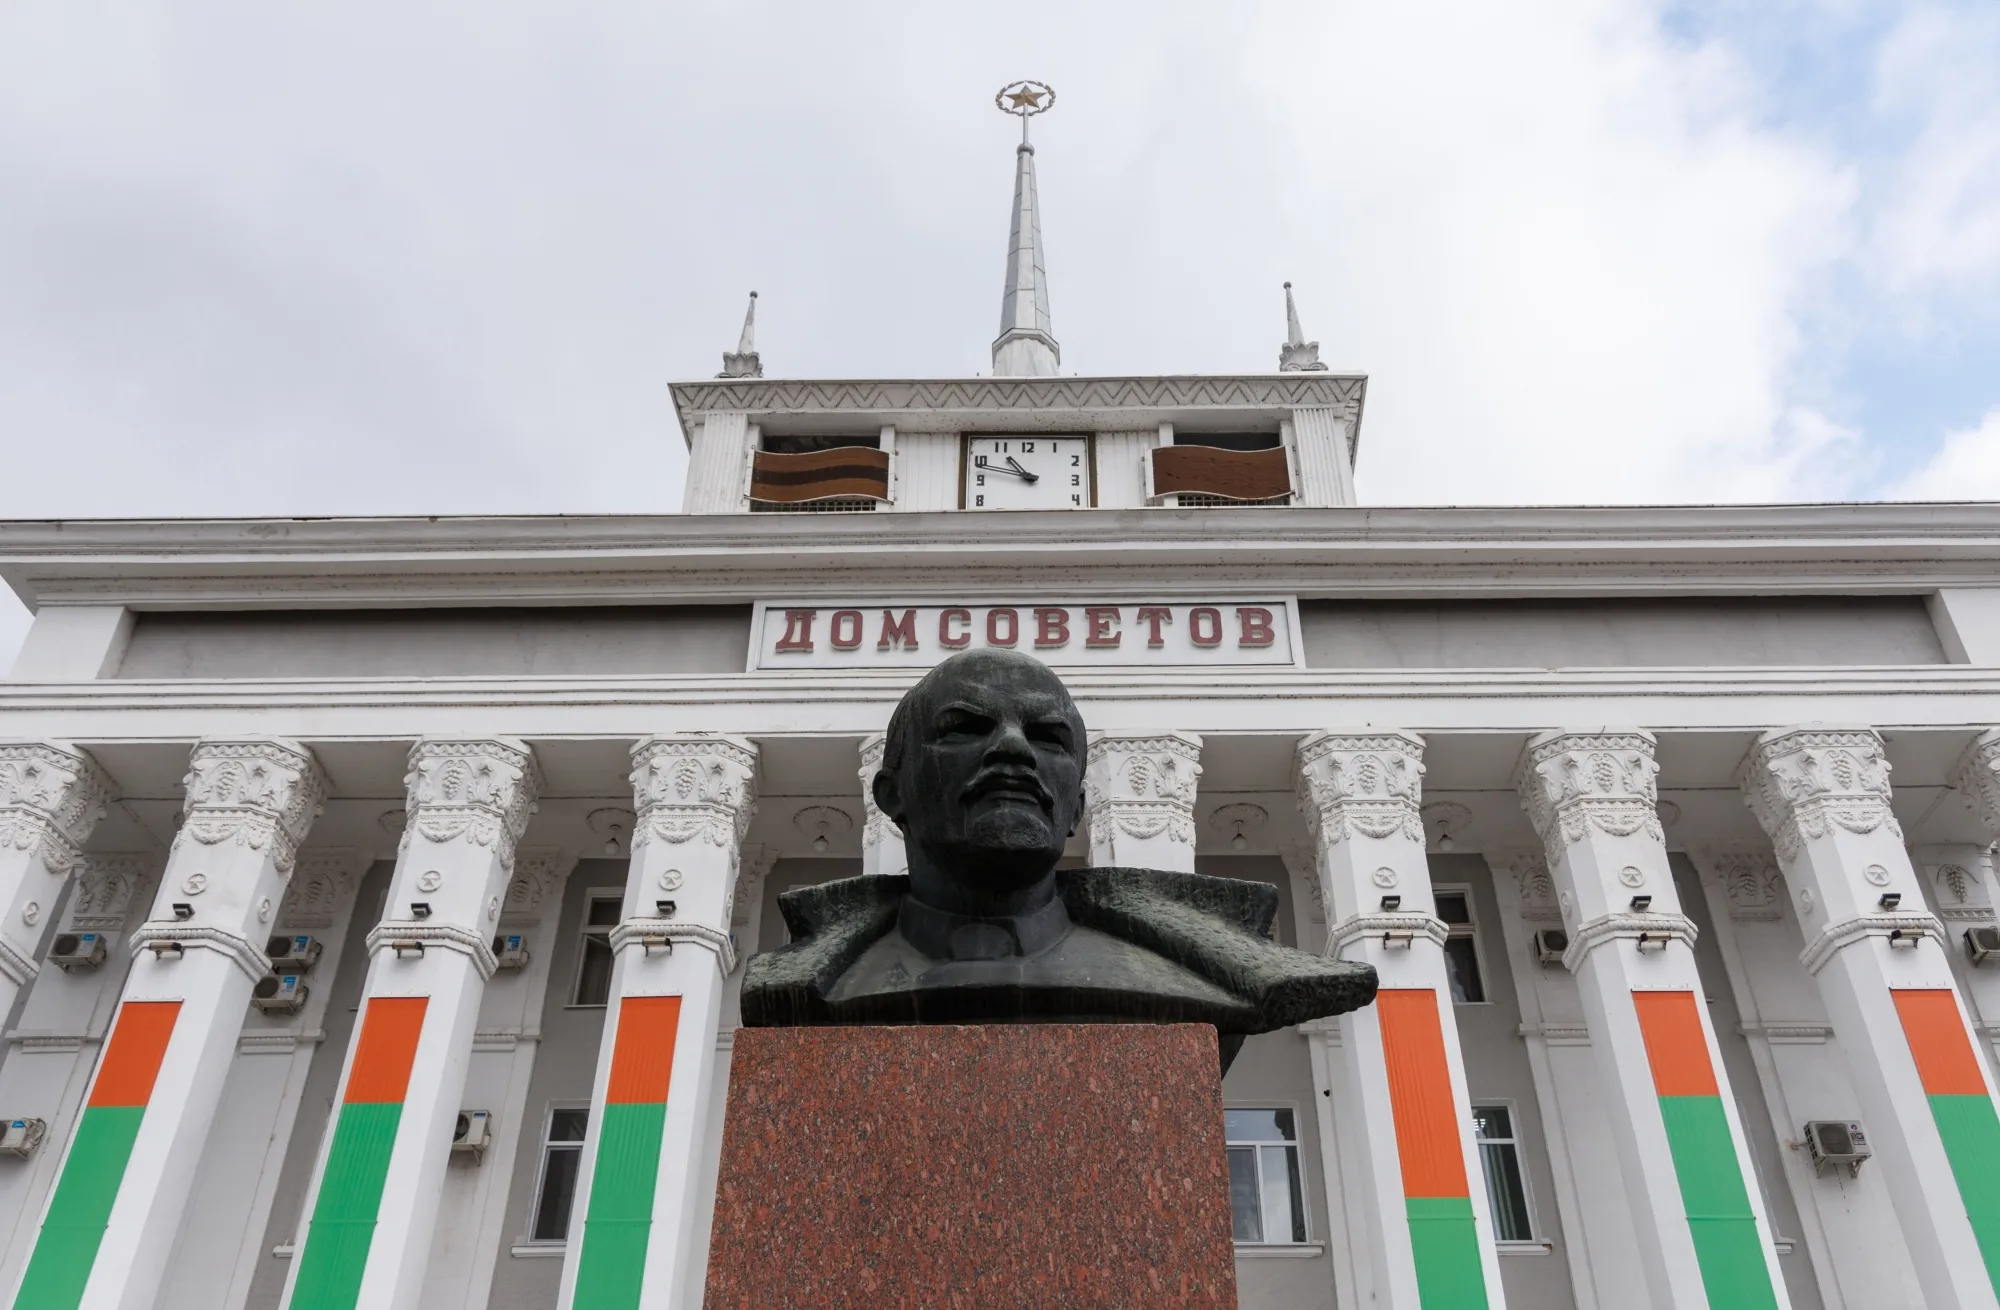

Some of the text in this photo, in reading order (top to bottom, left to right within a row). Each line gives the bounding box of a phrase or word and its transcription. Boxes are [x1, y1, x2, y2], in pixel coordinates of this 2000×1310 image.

[995, 442, 1008, 453] 11
[1022, 442, 1034, 453] 12
[1053, 442, 1057, 453] 1
[1071, 455, 1079, 466] 2
[976, 474, 984, 486] 9
[1071, 474, 1080, 486] 3
[976, 495, 984, 506] 8
[1071, 494, 1080, 505] 4
[776, 607, 1275, 653] ДОМ СОВЕТОВ
